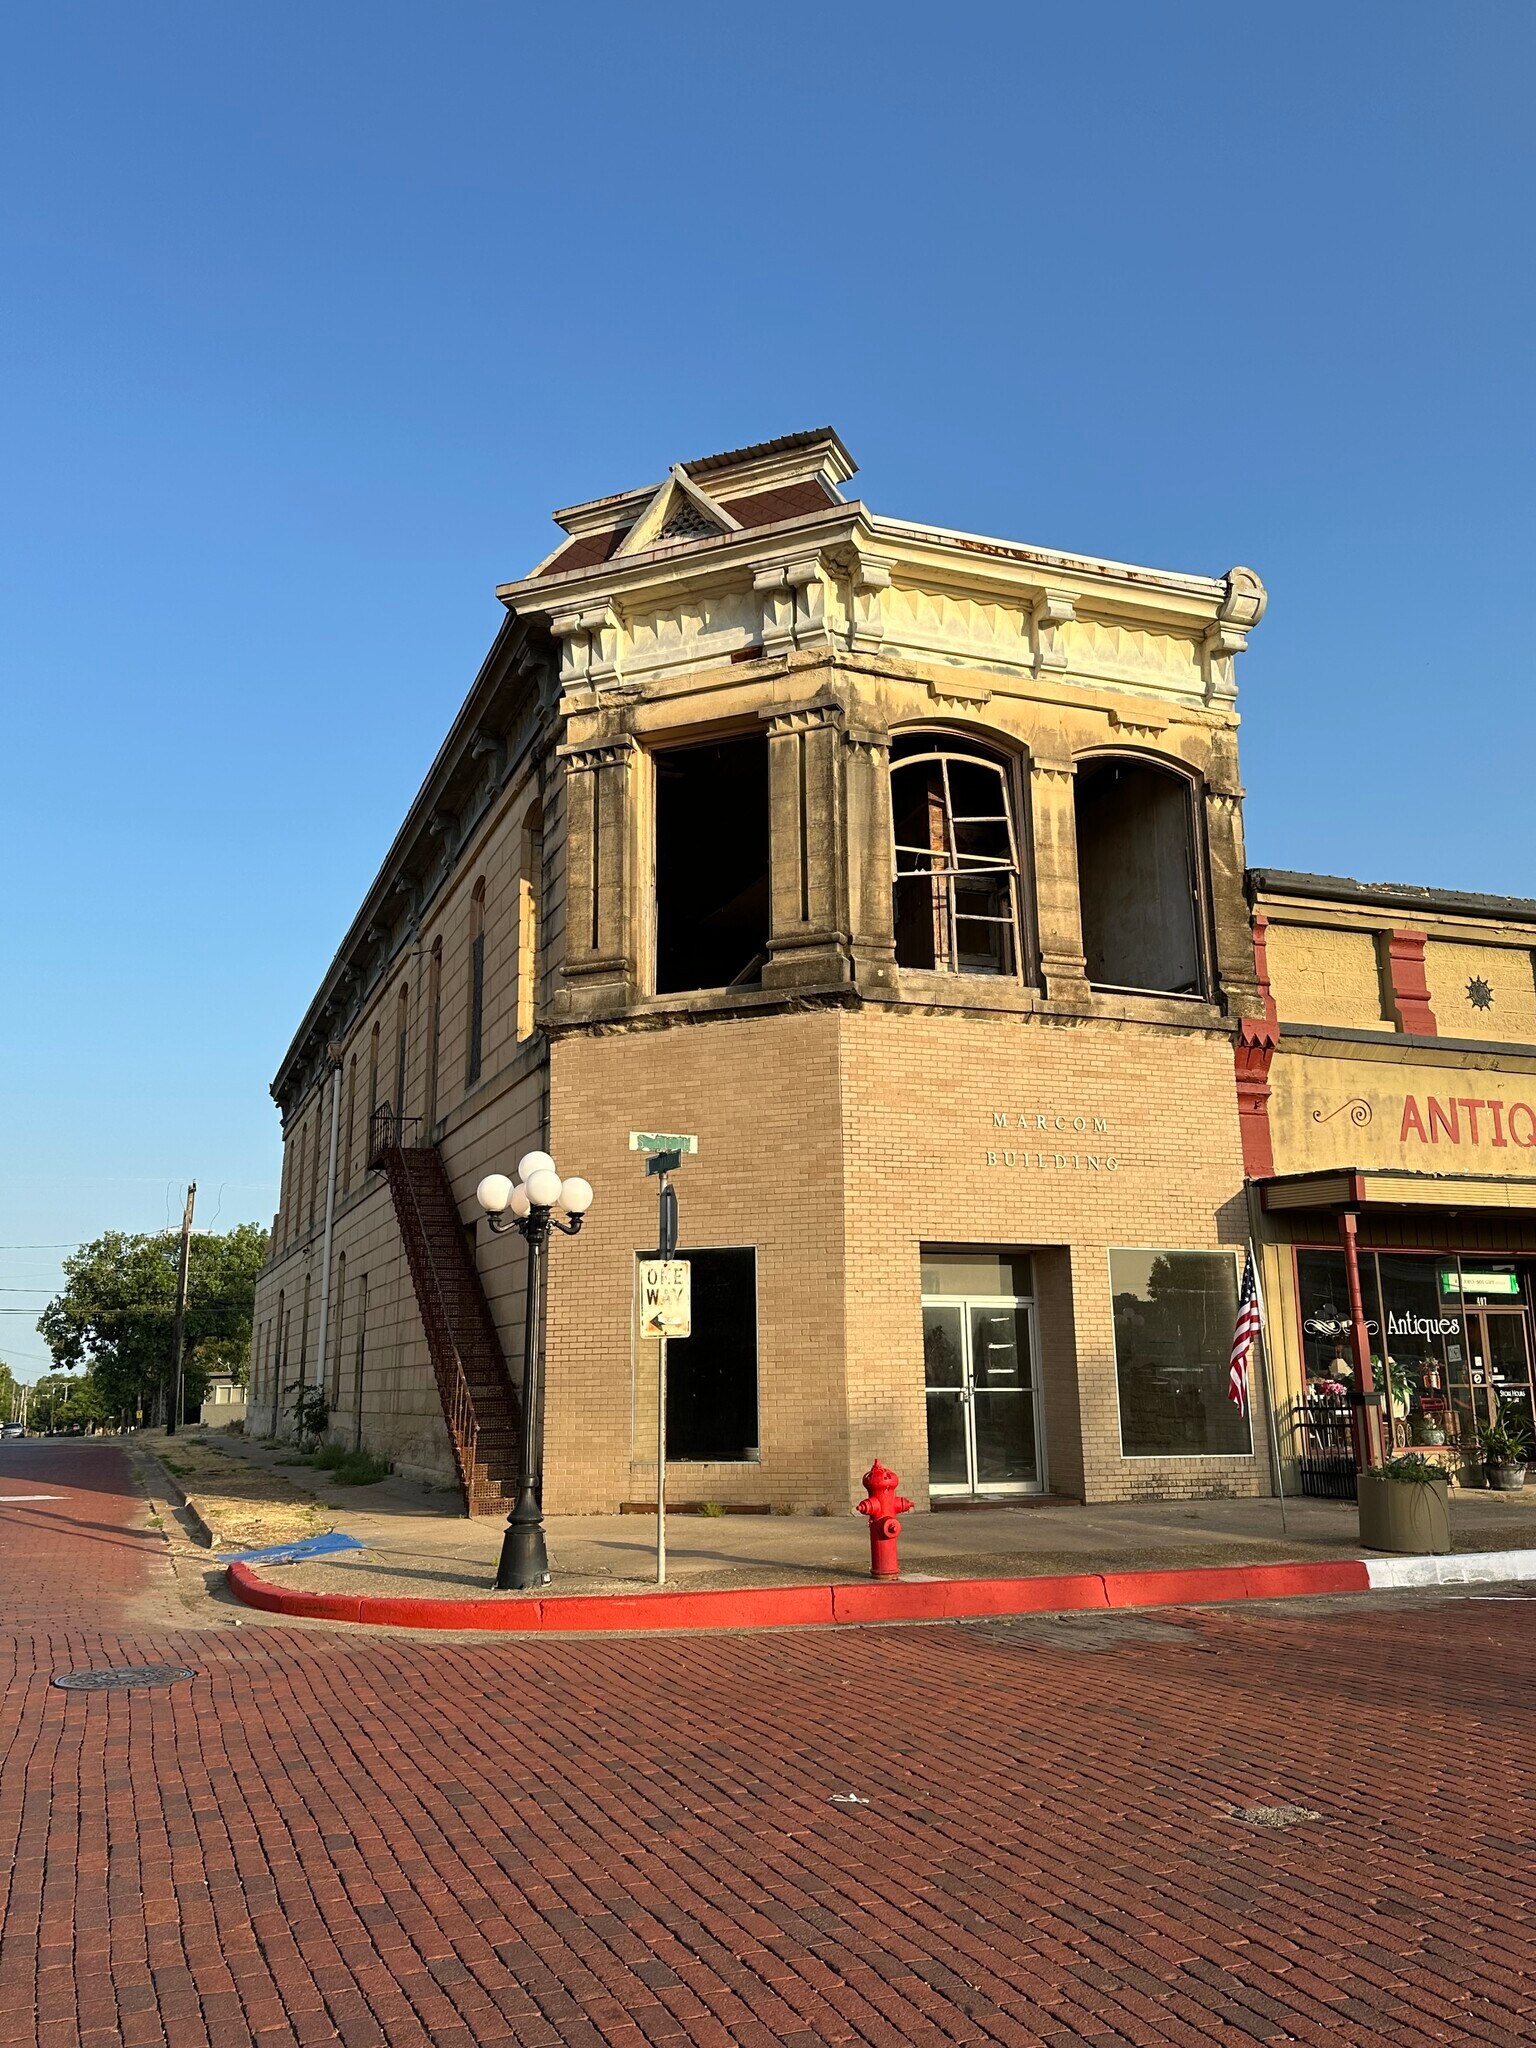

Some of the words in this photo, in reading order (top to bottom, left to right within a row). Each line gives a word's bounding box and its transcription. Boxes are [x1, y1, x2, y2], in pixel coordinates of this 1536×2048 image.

[992, 1112, 1108, 1133] MARCOM
[1400, 1094, 1536, 1148] ANTIQ
[986, 1151, 1119, 1171] BUILDING
[1387, 1310, 1460, 1343] Antiques
